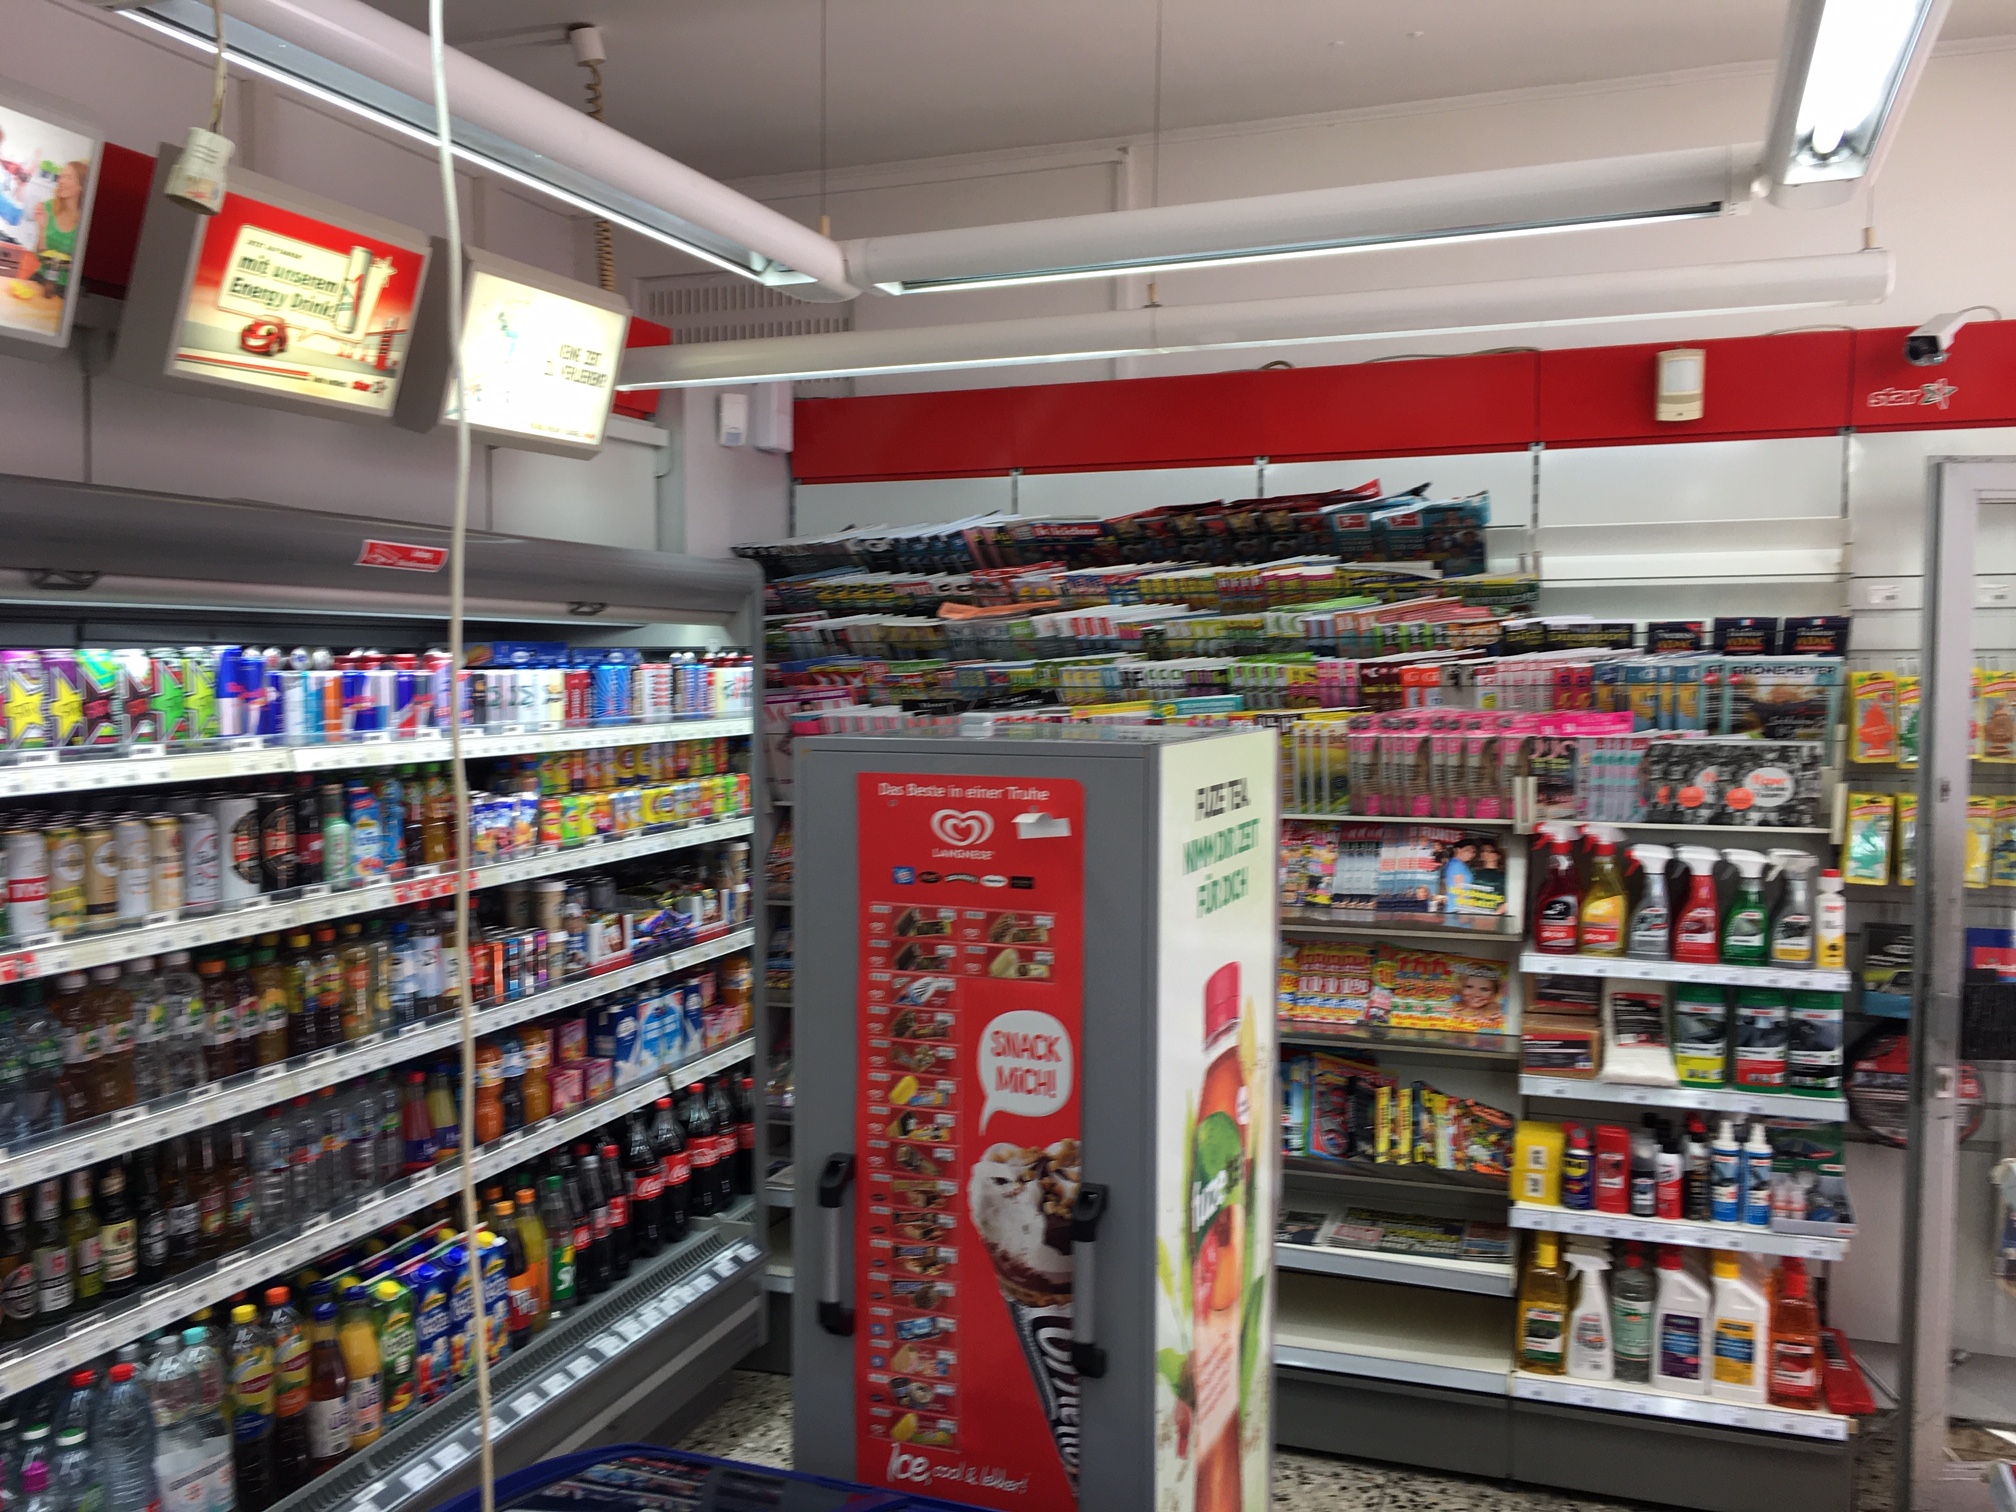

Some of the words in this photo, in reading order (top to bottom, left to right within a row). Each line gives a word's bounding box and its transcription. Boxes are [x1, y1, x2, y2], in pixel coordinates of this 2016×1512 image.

[238, 255, 271, 276] mit
[273, 264, 339, 294] unserem
[230, 276, 288, 309] Energy
[878, 782, 905, 797] Das
[905, 783, 947, 798] Beste
[948, 784, 963, 798] in
[965, 785, 1003, 799] einer
[1004, 786, 1051, 801] Truhe
[991, 1030, 1063, 1062] SNACK
